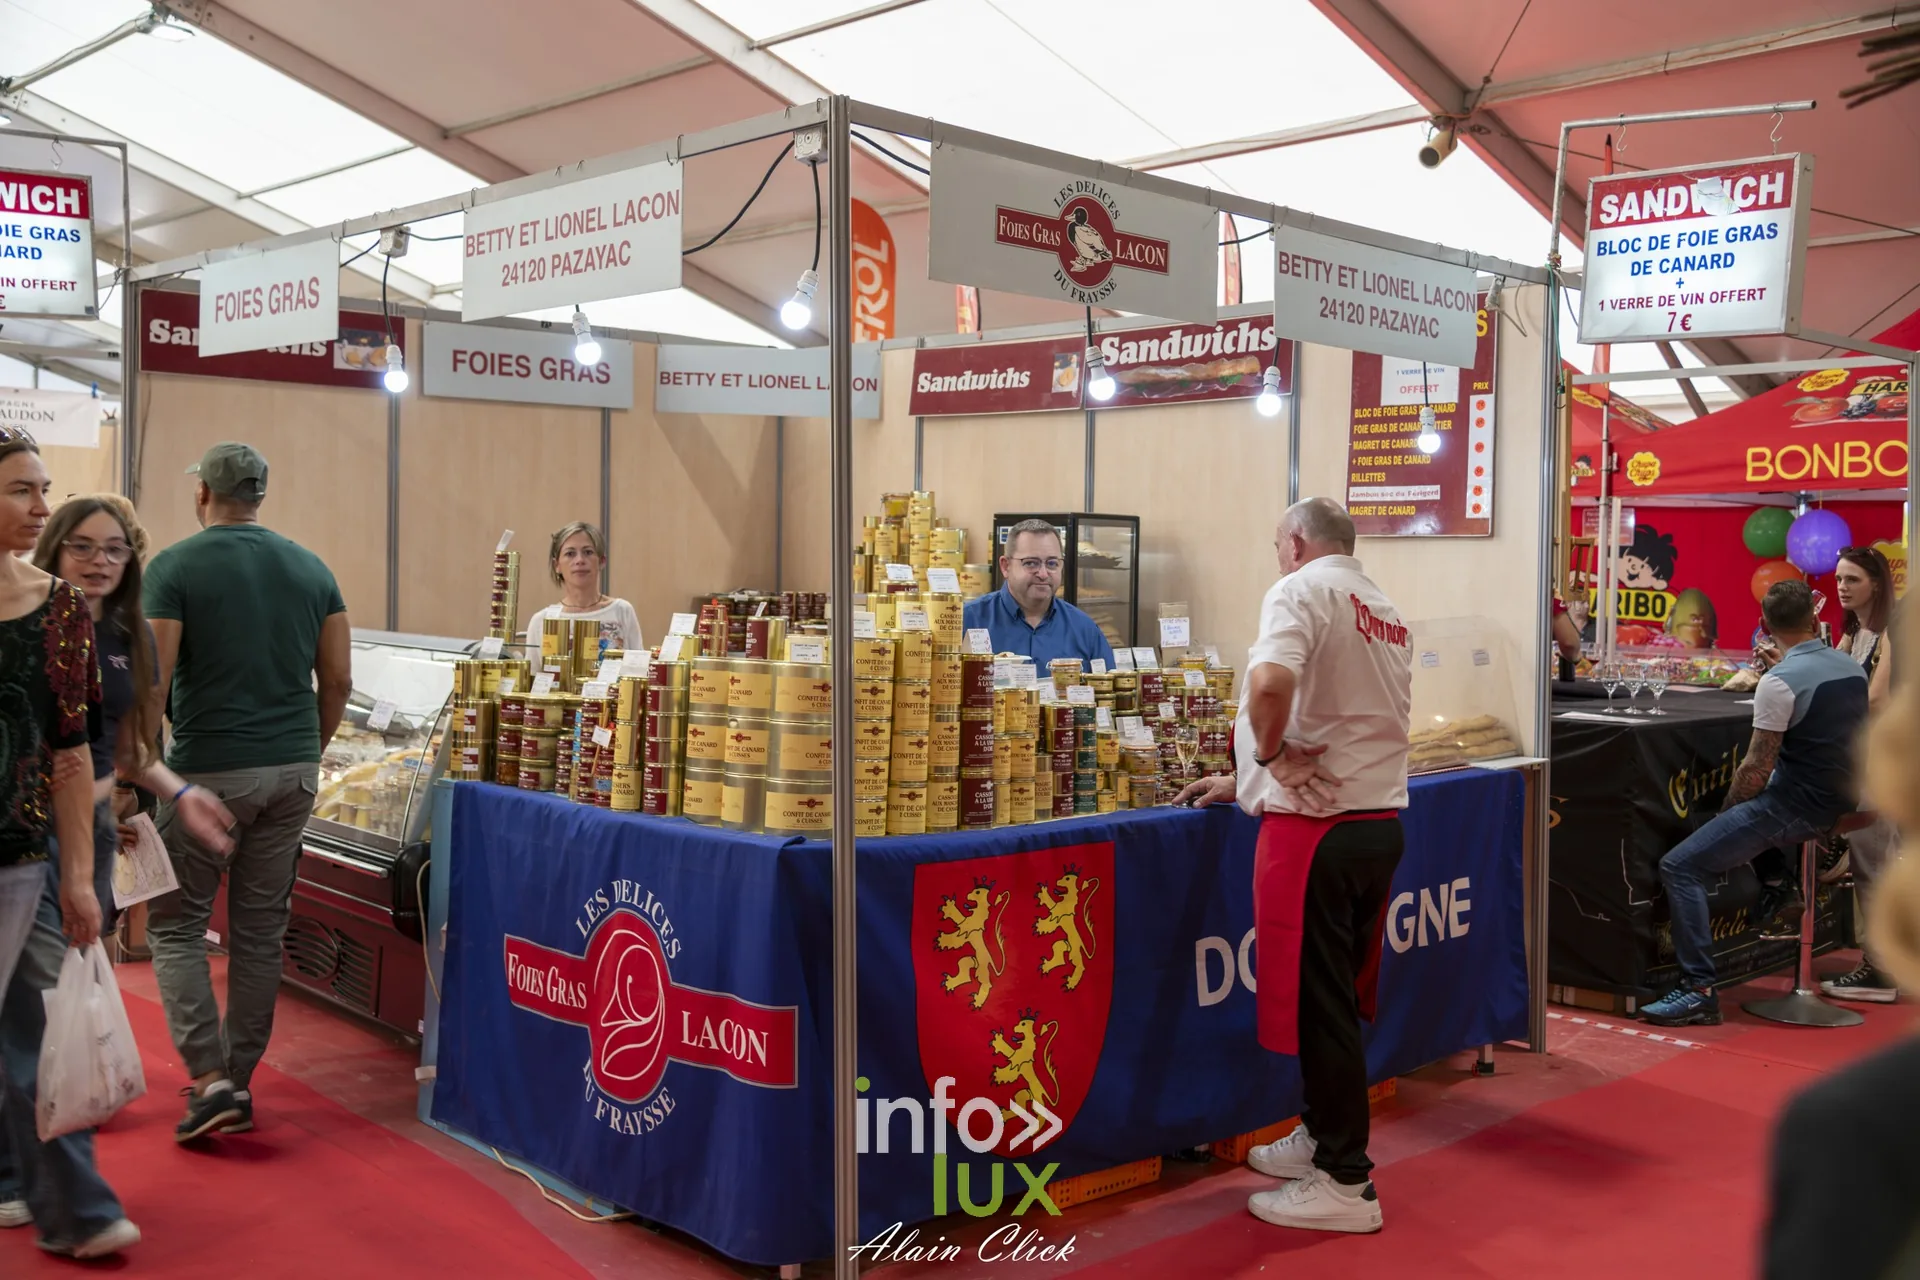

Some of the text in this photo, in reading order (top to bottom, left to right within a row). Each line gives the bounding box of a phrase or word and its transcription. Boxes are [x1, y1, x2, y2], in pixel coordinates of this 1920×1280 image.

[1053, 180, 1121, 220] LES DELICES
[1600, 172, 1785, 225] SANDICH
[0, 224, 81, 243] IE GRAS
[465, 189, 680, 258] BETTY ET LIONEL LACON
[999, 215, 1061, 247] FOIES GRAS
[0, 245, 42, 260] ARD
[1116, 238, 1166, 266] LACON
[1597, 222, 1779, 257] BLOC DE FOIE GRAS
[501, 240, 631, 288] 24120 PAZAYAC
[1630, 252, 1735, 277] DE CANARD
[21, 278, 77, 292] OFFERT
[1053, 268, 1117, 304] DU FRAYSSE
[1279, 251, 1476, 314] BETTY ET LIONEL LACON
[215, 276, 320, 324] FOIES GRAS
[1598, 287, 1767, 311] 1 VERRE DE VIN OFFERT
[1319, 296, 1365, 326] 24120
[1370, 305, 1440, 339] PAZAYAC
[1667, 311, 1693, 332] 7 €
[1100, 321, 1277, 367] Sandwichs
[452, 349, 611, 385] FOIES GRAS
[917, 367, 1030, 394] Sandwichs
[1401, 368, 1422, 376] VERRE
[660, 371, 878, 392] BETTY ET LIONEL LON
[1399, 383, 1440, 395] OFFERT
[1472, 381, 1489, 390] PRIX
[1354, 408, 1372, 418] BLOC
[1373, 407, 1382, 417] DE
[1383, 406, 1398, 416] FOIE
[1399, 405, 1417, 416] GRAS
[1353, 424, 1369, 434] FOIE
[1370, 423, 1387, 433] GRAS
[1388, 422, 1398, 432] DE
[1353, 439, 1380, 450] MAGRET
[1381, 439, 1390, 449] DE
[1358, 456, 1373, 466] FOIE
[1374, 455, 1392, 466] GRAS
[1393, 455, 1402, 465] DE
[1404, 454, 1431, 465] CANARD
[1351, 472, 1386, 483] RILLETTES
[1349, 505, 1416, 516] MAGRET DE CANARD
[783, 810, 805, 818] CONFIT
[575, 878, 682, 960] LES DELICES
[507, 952, 588, 1010] FOIES GRAS
[681, 1010, 769, 1068] LACON
[594, 1086, 677, 1136] FRAYSSE
